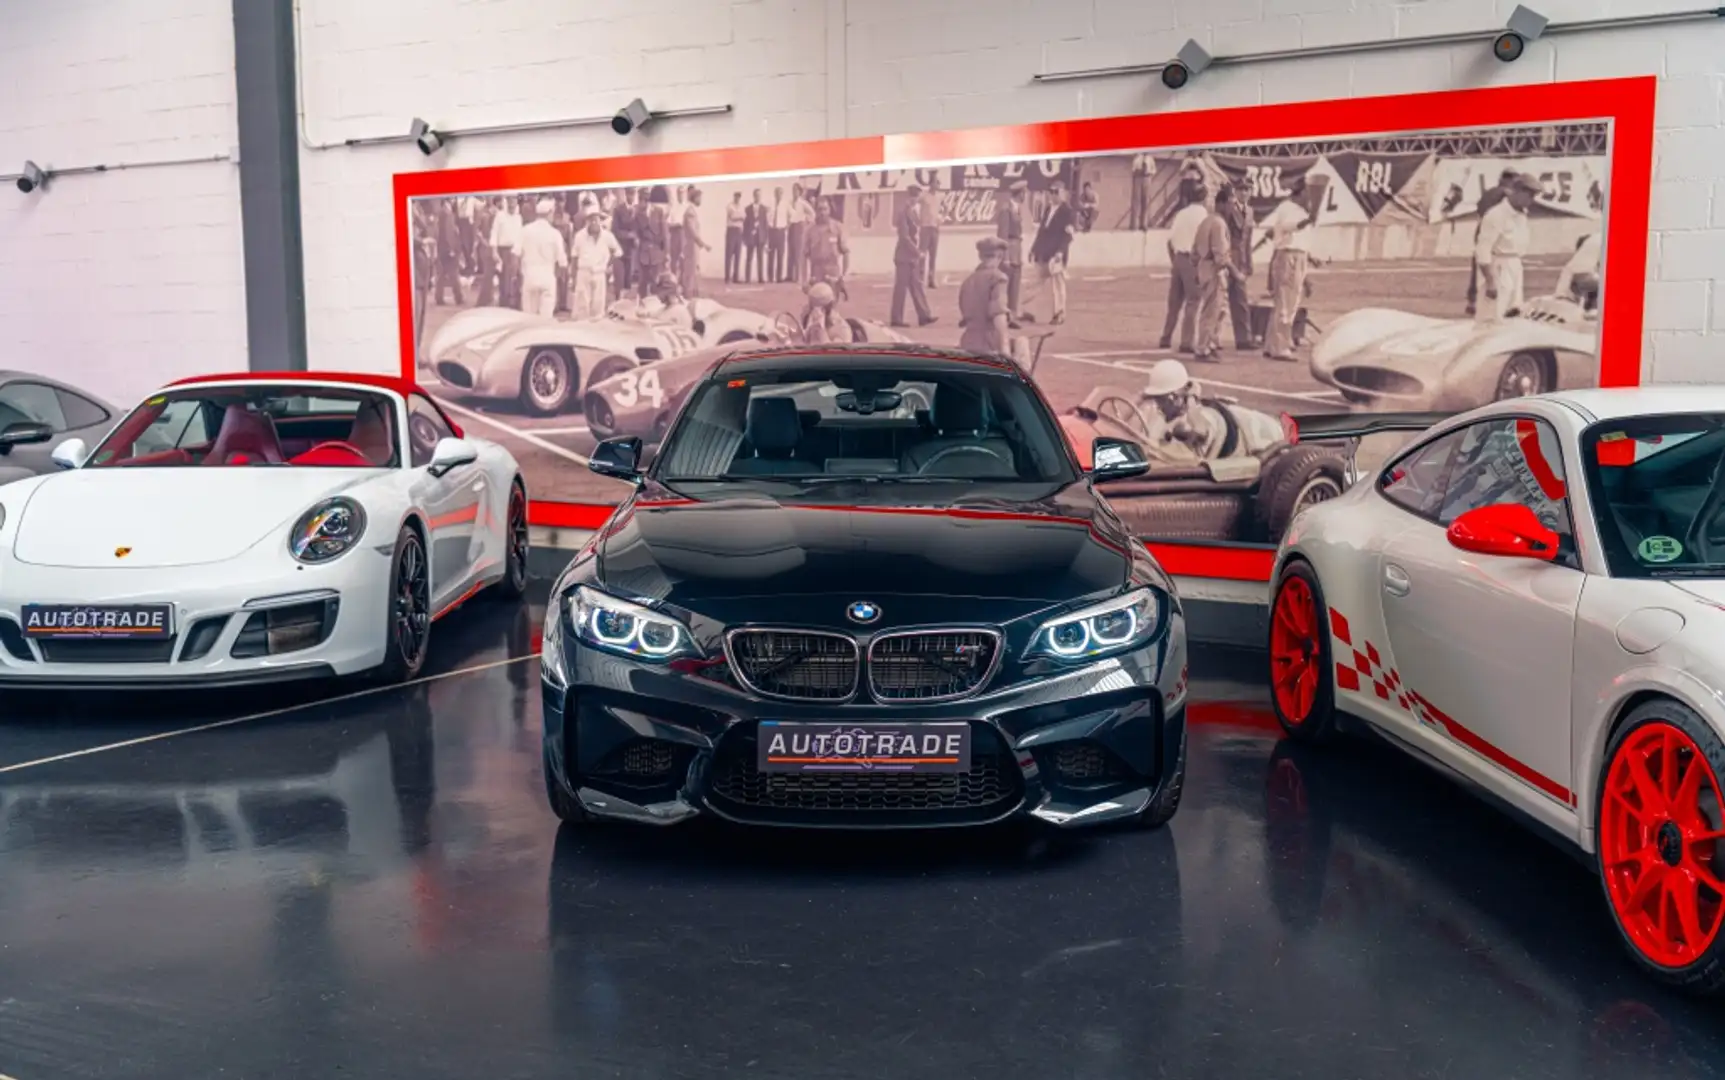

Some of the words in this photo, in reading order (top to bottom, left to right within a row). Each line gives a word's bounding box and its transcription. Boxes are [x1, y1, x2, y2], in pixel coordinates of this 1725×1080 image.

[613, 370, 664, 409] 34
[28, 611, 164, 627] AUTOTRADE
[768, 734, 962, 755] AUTOTRADE
